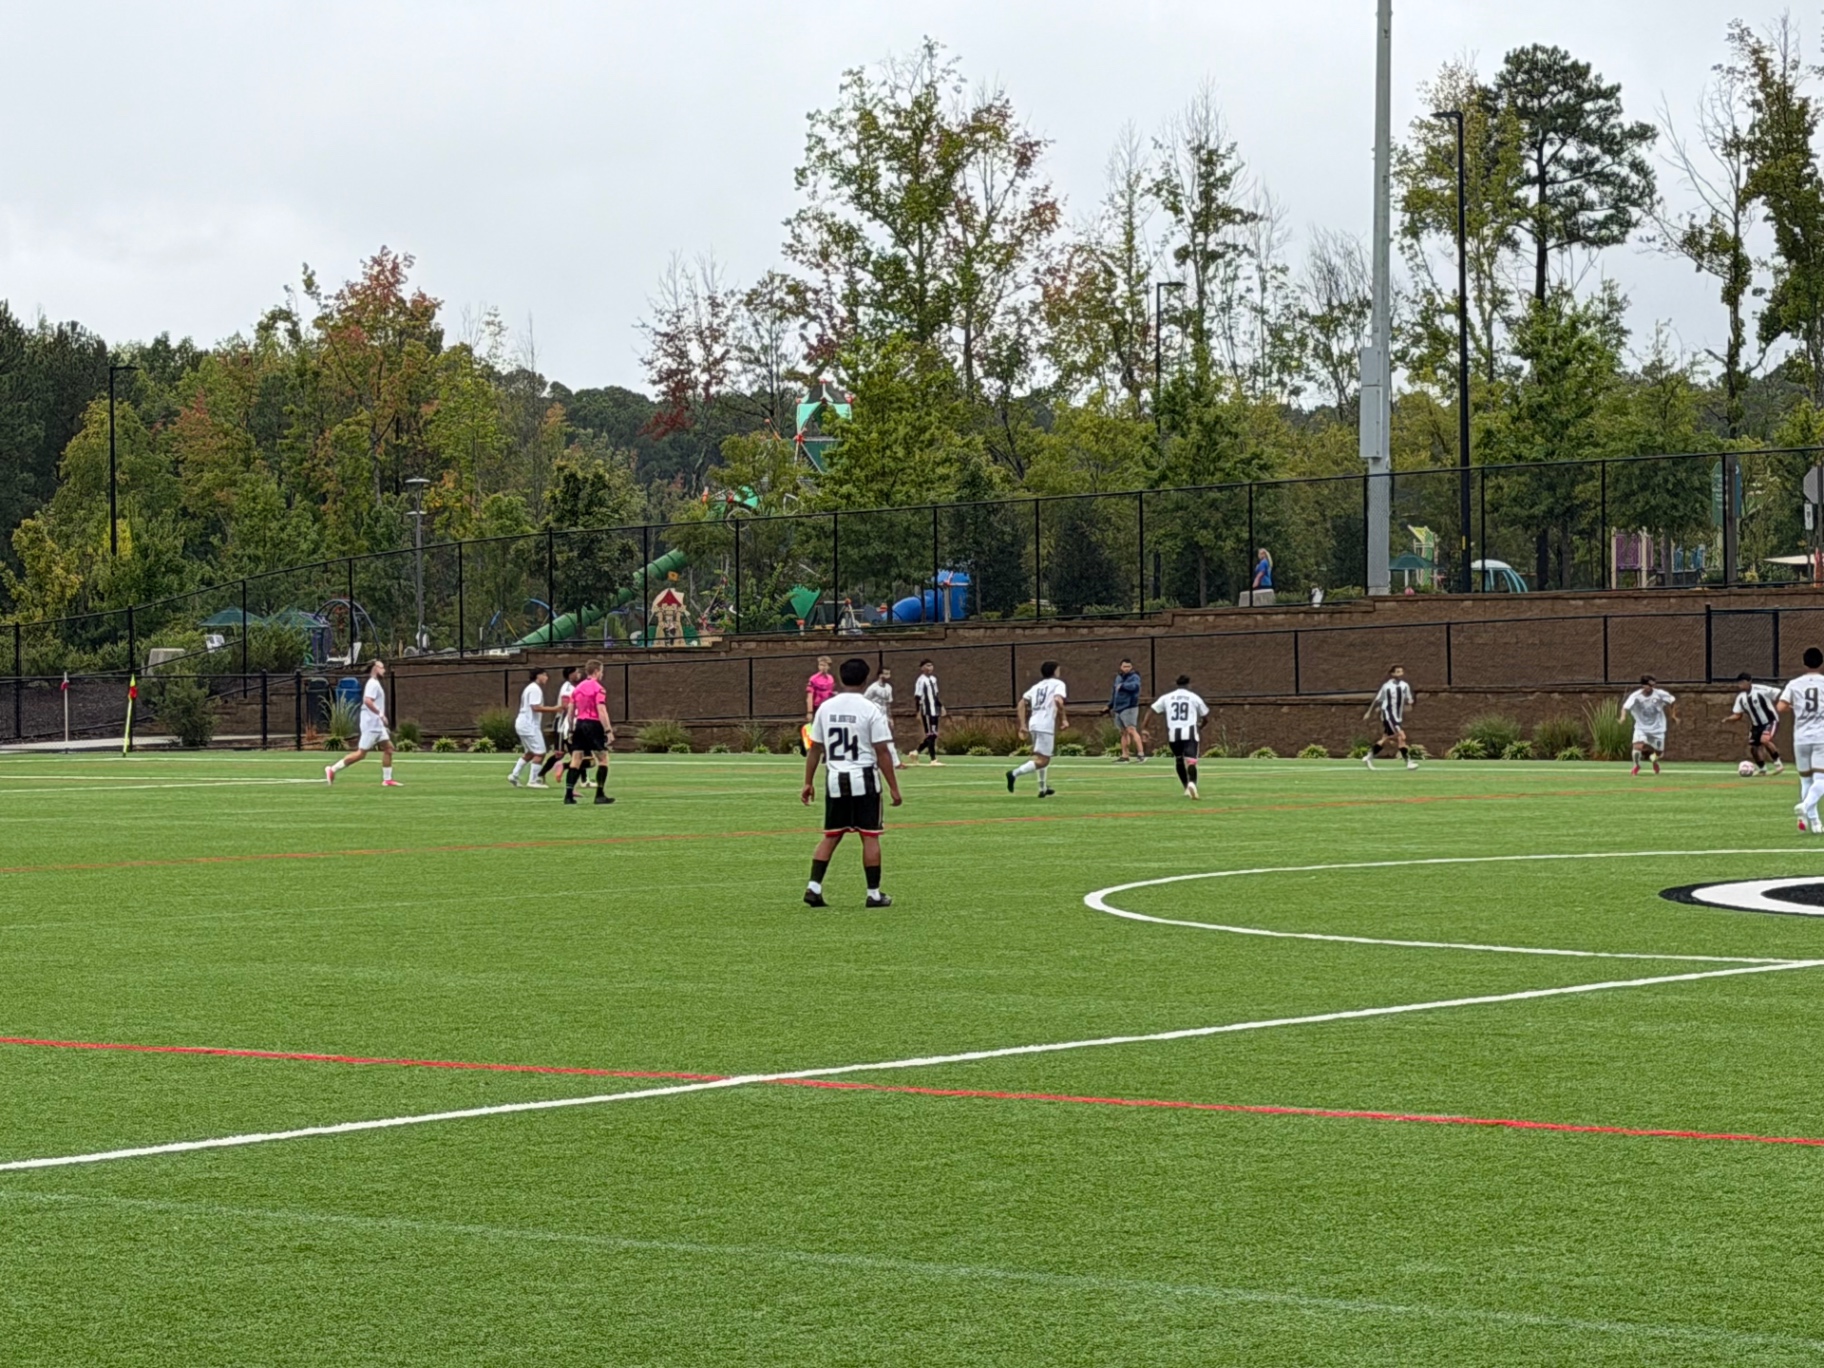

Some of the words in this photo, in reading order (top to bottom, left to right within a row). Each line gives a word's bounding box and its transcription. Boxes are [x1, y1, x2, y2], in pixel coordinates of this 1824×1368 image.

[1171, 702, 1189, 721] 39
[1805, 687, 1818, 712] 9
[828, 727, 858, 761] 24
